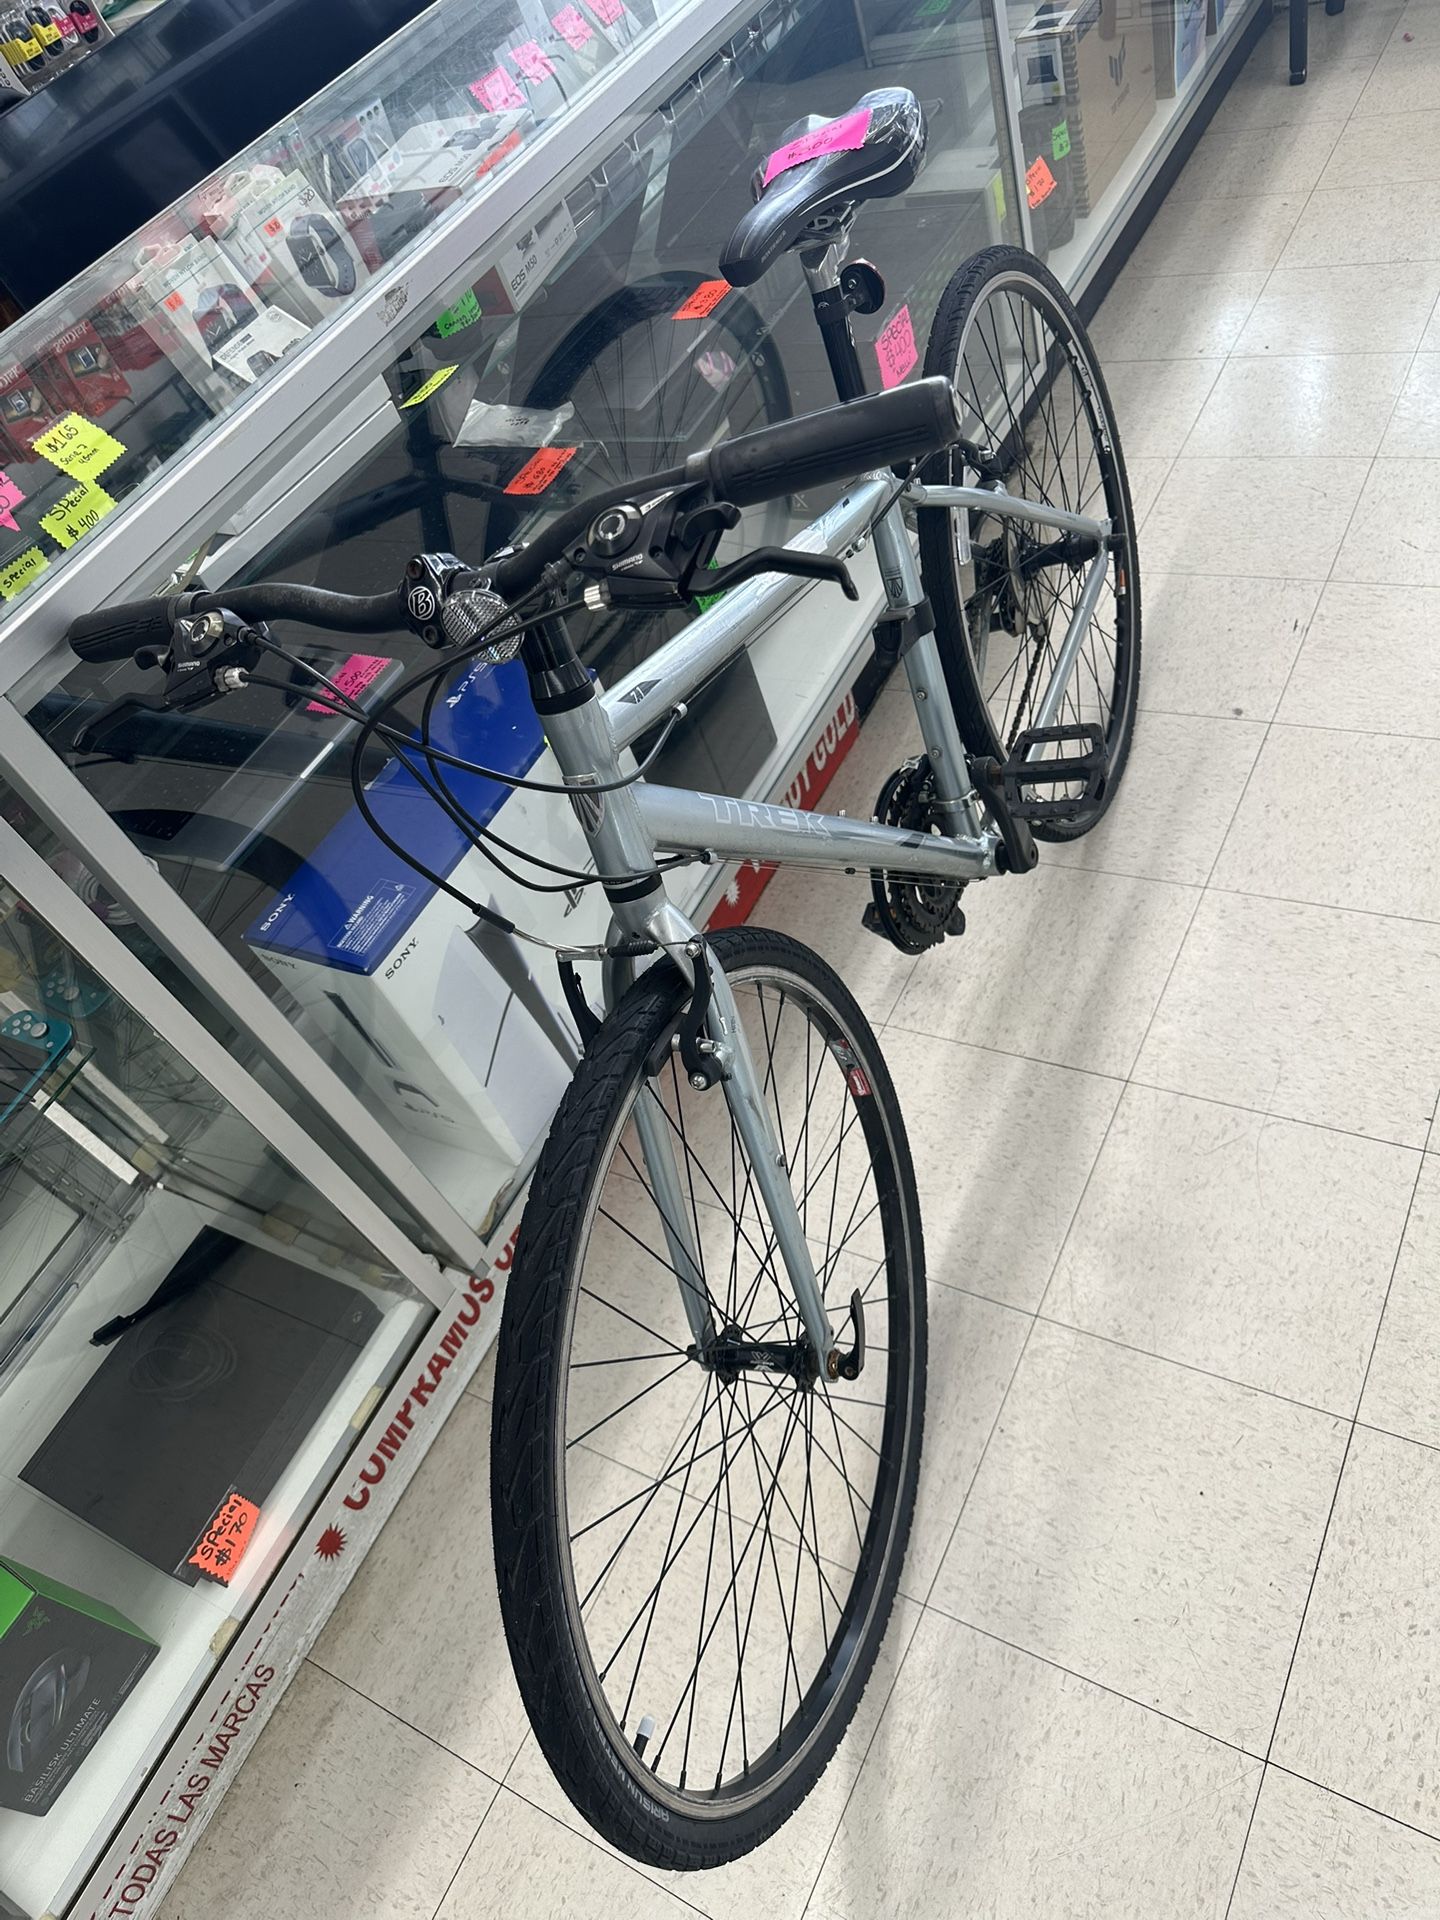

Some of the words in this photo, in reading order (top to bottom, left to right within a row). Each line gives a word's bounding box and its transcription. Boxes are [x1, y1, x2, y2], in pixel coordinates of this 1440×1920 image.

[510, 268, 526, 291] EOS
[524, 254, 538, 276] M50
[45, 424, 79, 454] $165
[458, 662, 488, 692] PS5
[697, 792, 831, 837] TREK
[260, 892, 295, 932] SONY
[385, 937, 418, 980] SONY
[24, 1752, 63, 1804] BASILISK
[60, 1697, 101, 1752] ULTIMATE
[109, 1827, 178, 1919] TODAS
[167, 1773, 212, 1825] LAS
[200, 1664, 276, 1771] MARCAS
[627, 1783, 670, 1823] ARISUN
